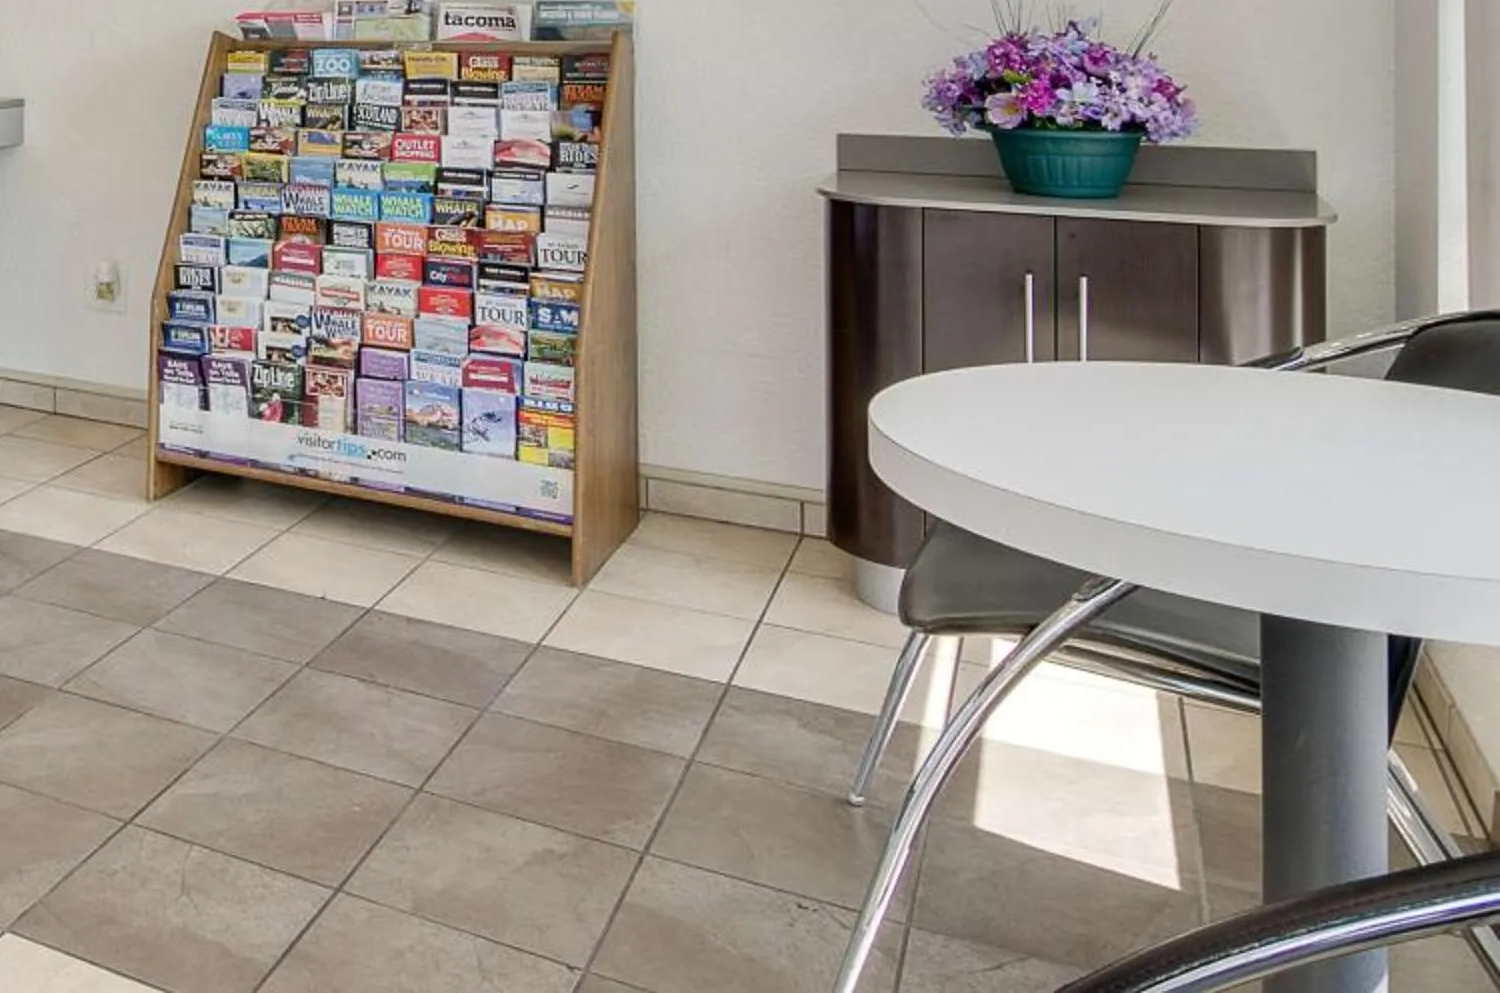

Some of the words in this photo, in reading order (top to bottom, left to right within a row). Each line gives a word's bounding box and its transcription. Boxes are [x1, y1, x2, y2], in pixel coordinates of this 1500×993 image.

[444, 11, 517, 29] tacoma
[314, 57, 351, 74] ZOO
[395, 138, 436, 150] OUTLET
[383, 233, 424, 250] TOUR
[540, 248, 588, 265] TOUR
[369, 285, 412, 299] KAYAK
[478, 306, 525, 326] TOUR
[367, 322, 407, 342] TOUR
